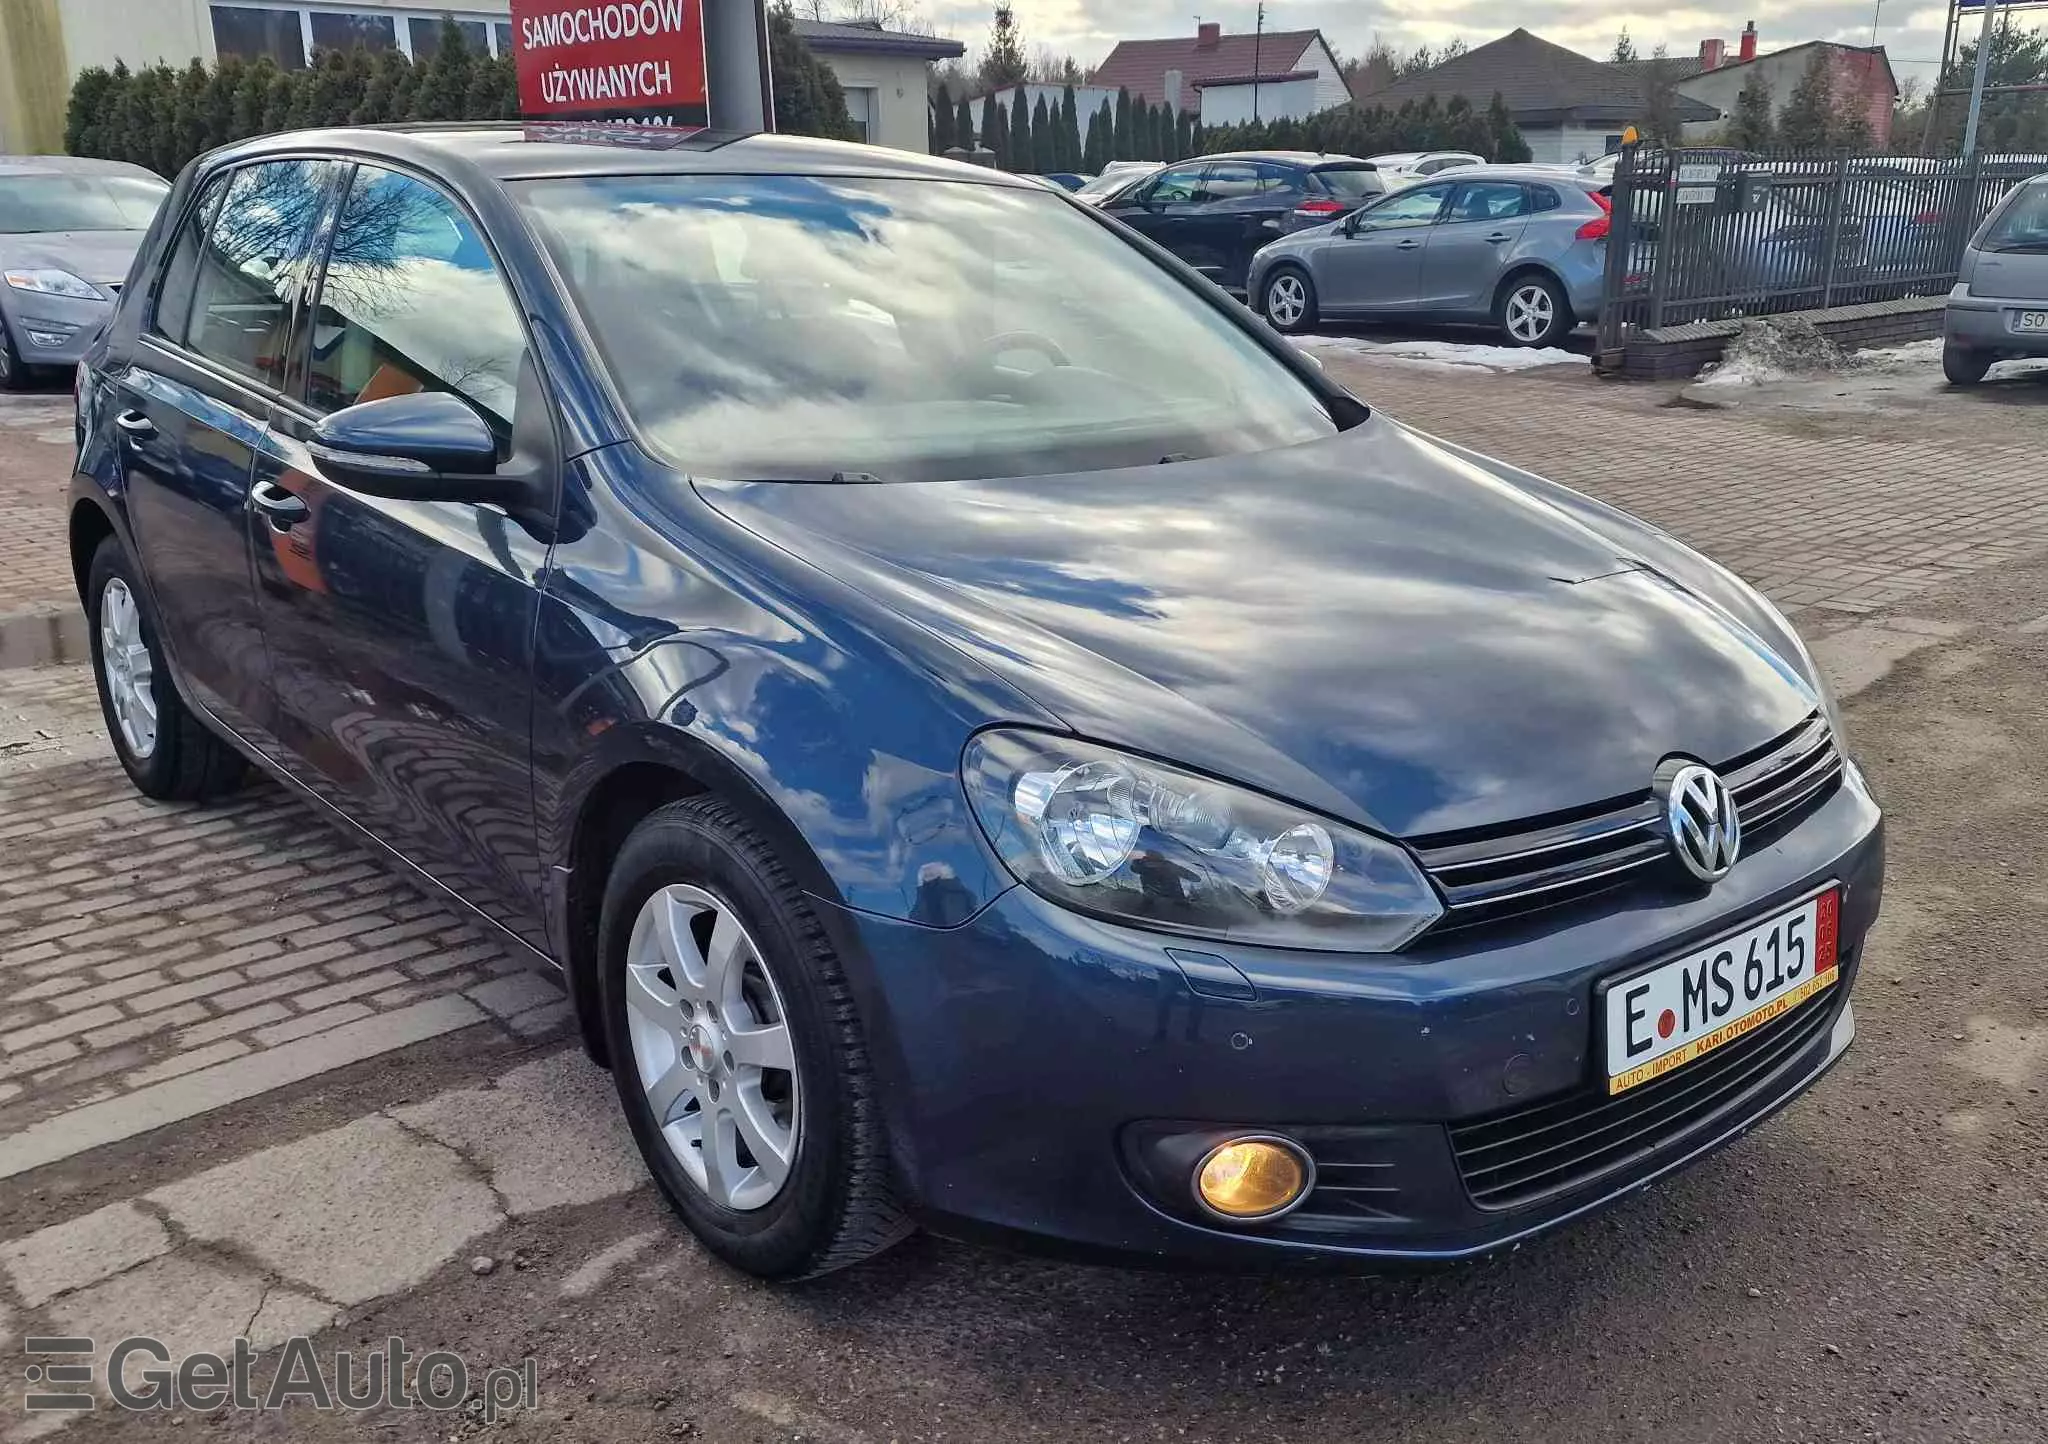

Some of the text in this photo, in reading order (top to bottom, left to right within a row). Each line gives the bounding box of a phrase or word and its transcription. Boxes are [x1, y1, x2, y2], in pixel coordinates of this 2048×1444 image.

[541, 60, 673, 104] UŻYWANYCH
[1626, 913, 1806, 1058] E MS 615
